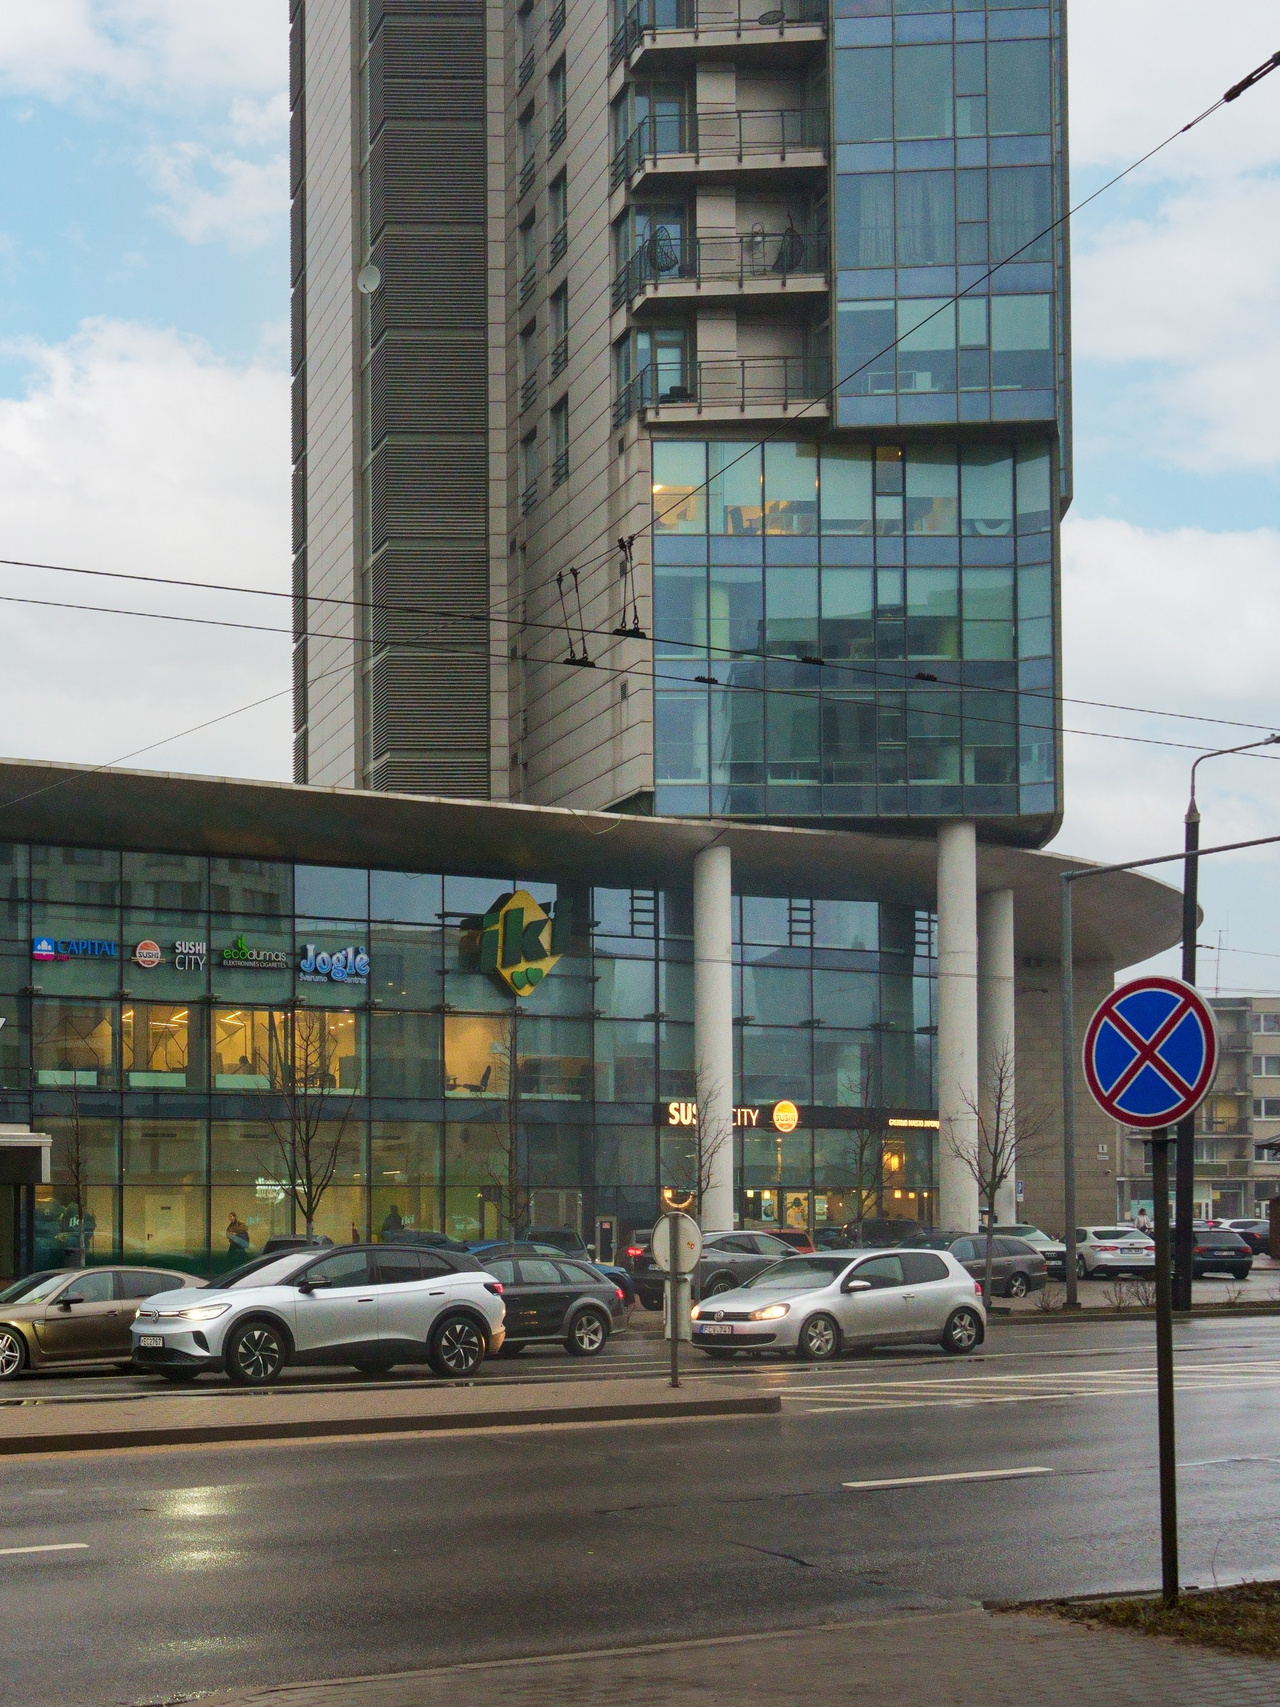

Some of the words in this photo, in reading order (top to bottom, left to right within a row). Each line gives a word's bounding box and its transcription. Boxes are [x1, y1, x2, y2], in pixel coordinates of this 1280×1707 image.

[57, 939, 117, 957] CAPITAL
[138, 951, 159, 959] SUSHI
[175, 941, 207, 954] SUSHI
[175, 955, 207, 971] CITY
[300, 944, 370, 981] Joglė
[668, 1102, 697, 1125] SUS
